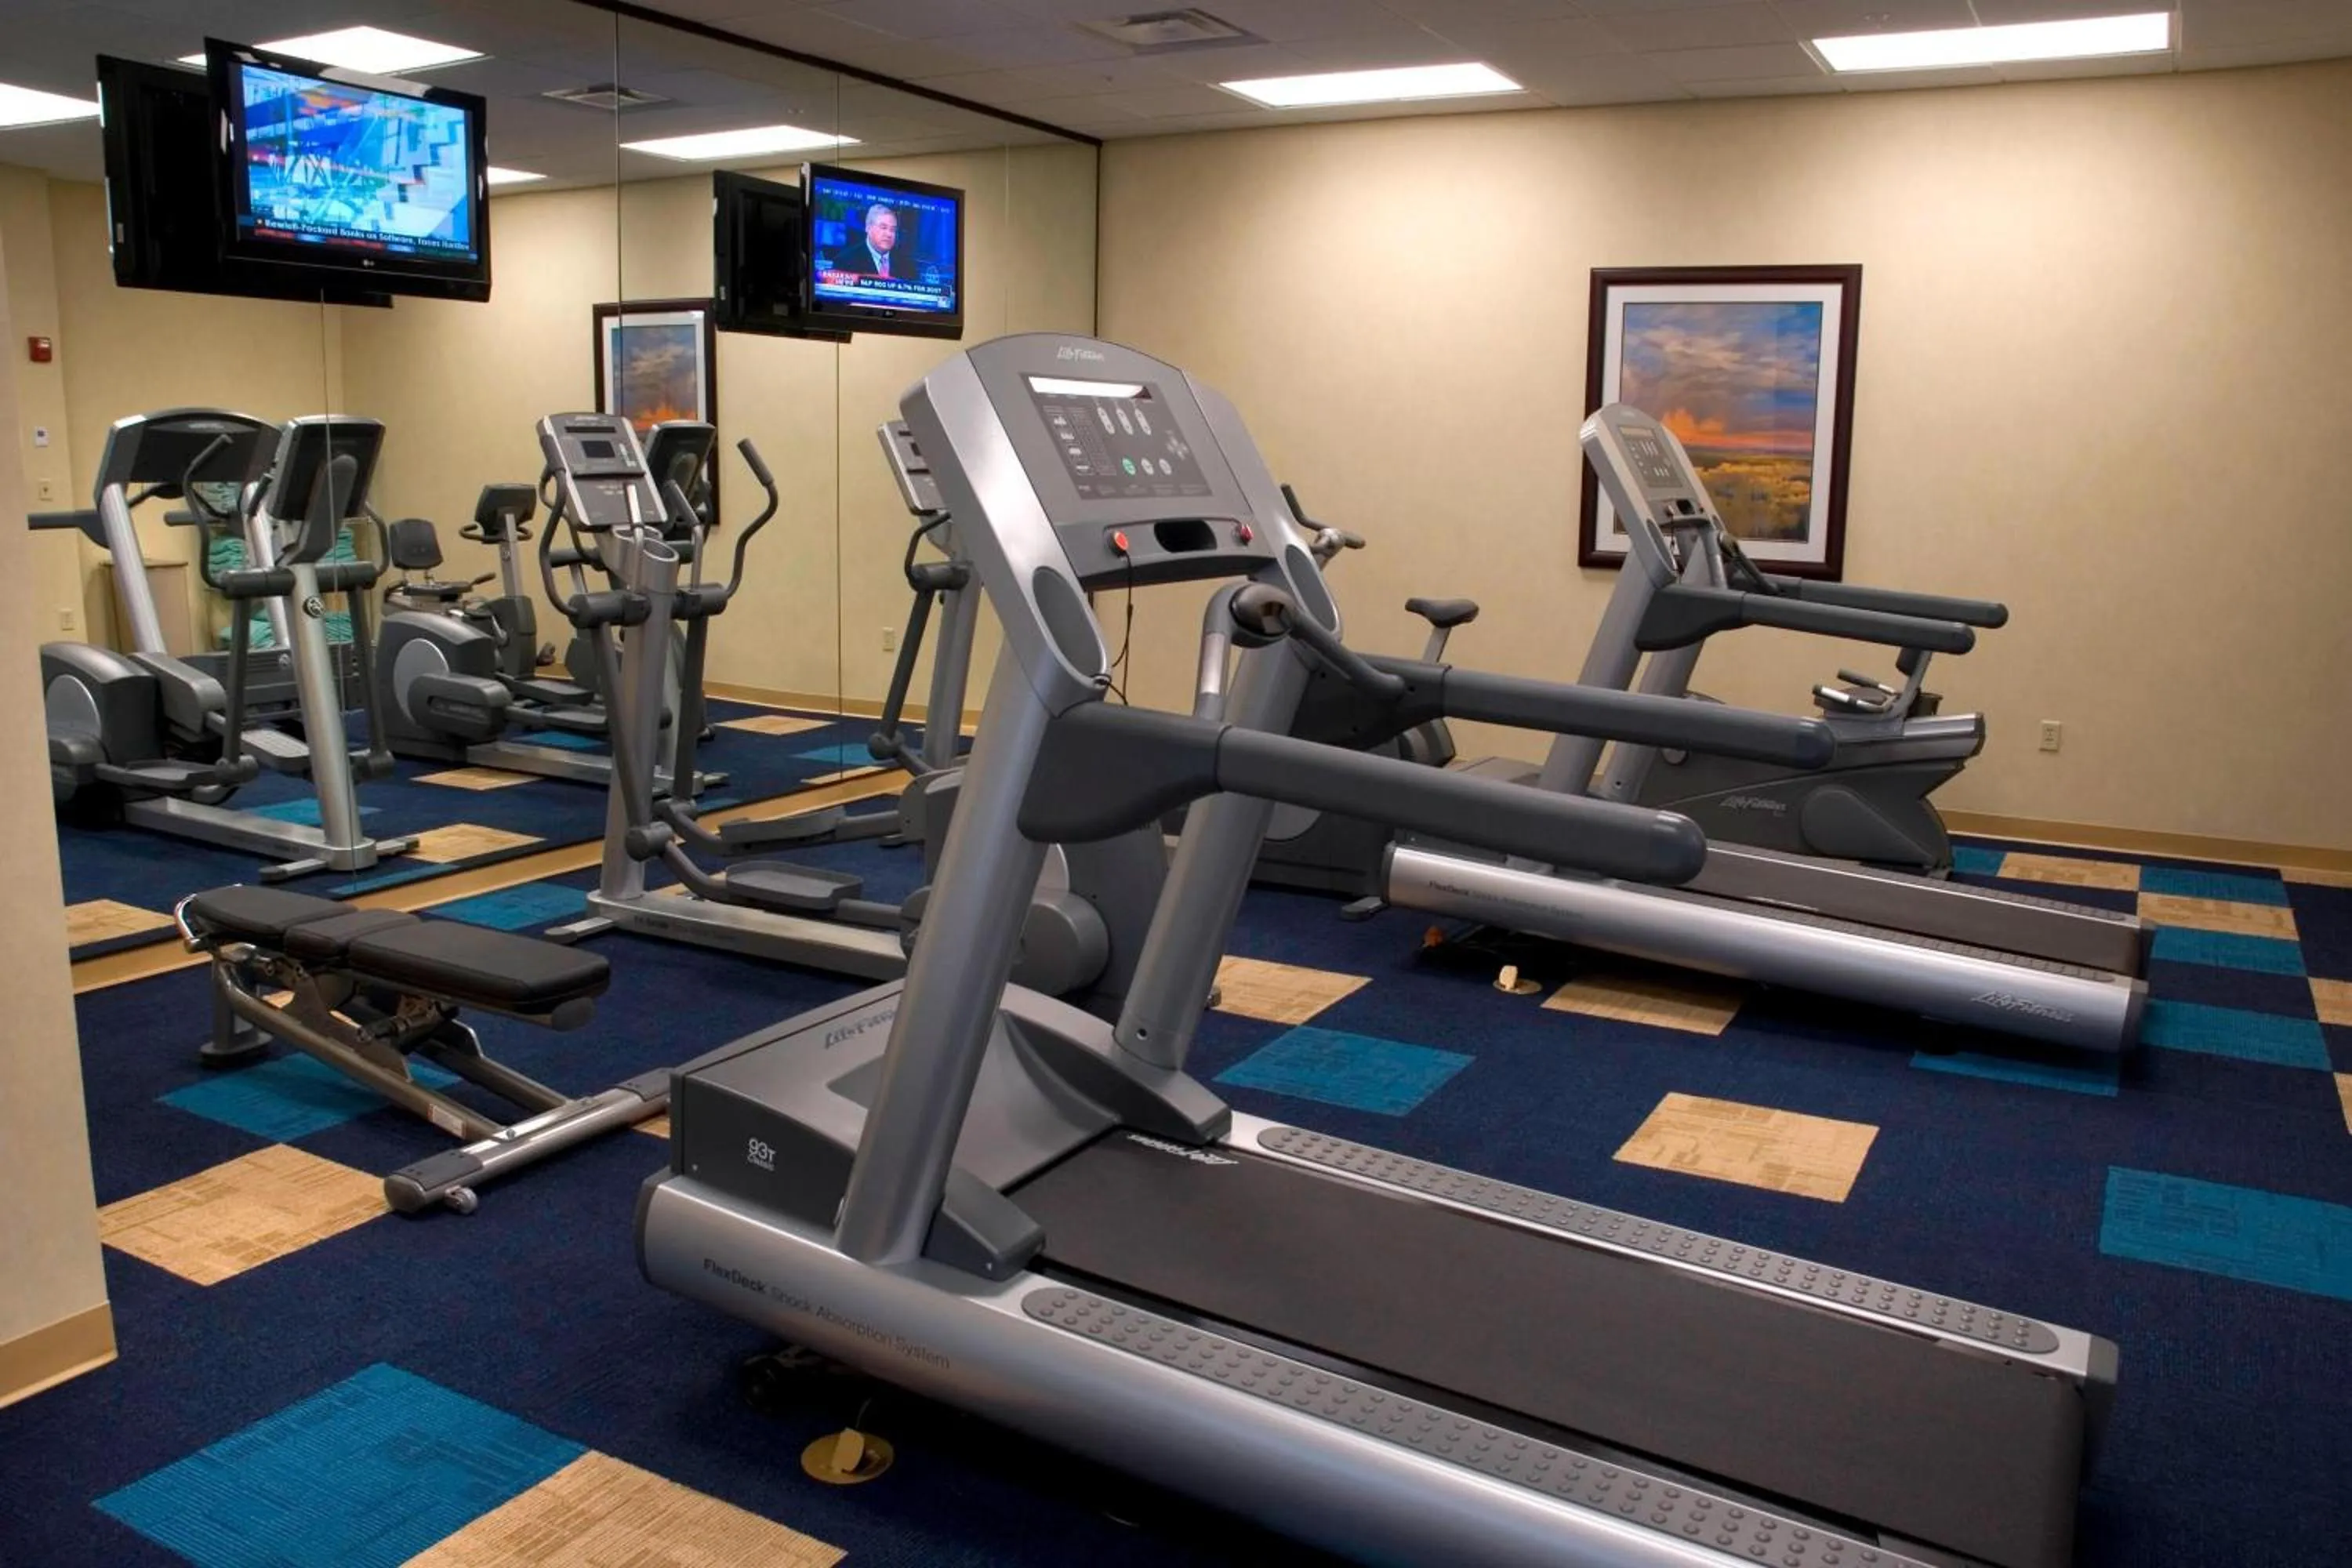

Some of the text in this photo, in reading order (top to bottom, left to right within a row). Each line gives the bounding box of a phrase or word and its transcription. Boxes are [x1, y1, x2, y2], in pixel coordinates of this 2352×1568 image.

[703, 1258, 767, 1294] FlexDeck
[815, 1305, 892, 1348] Absorption
[895, 1335, 951, 1370] System
